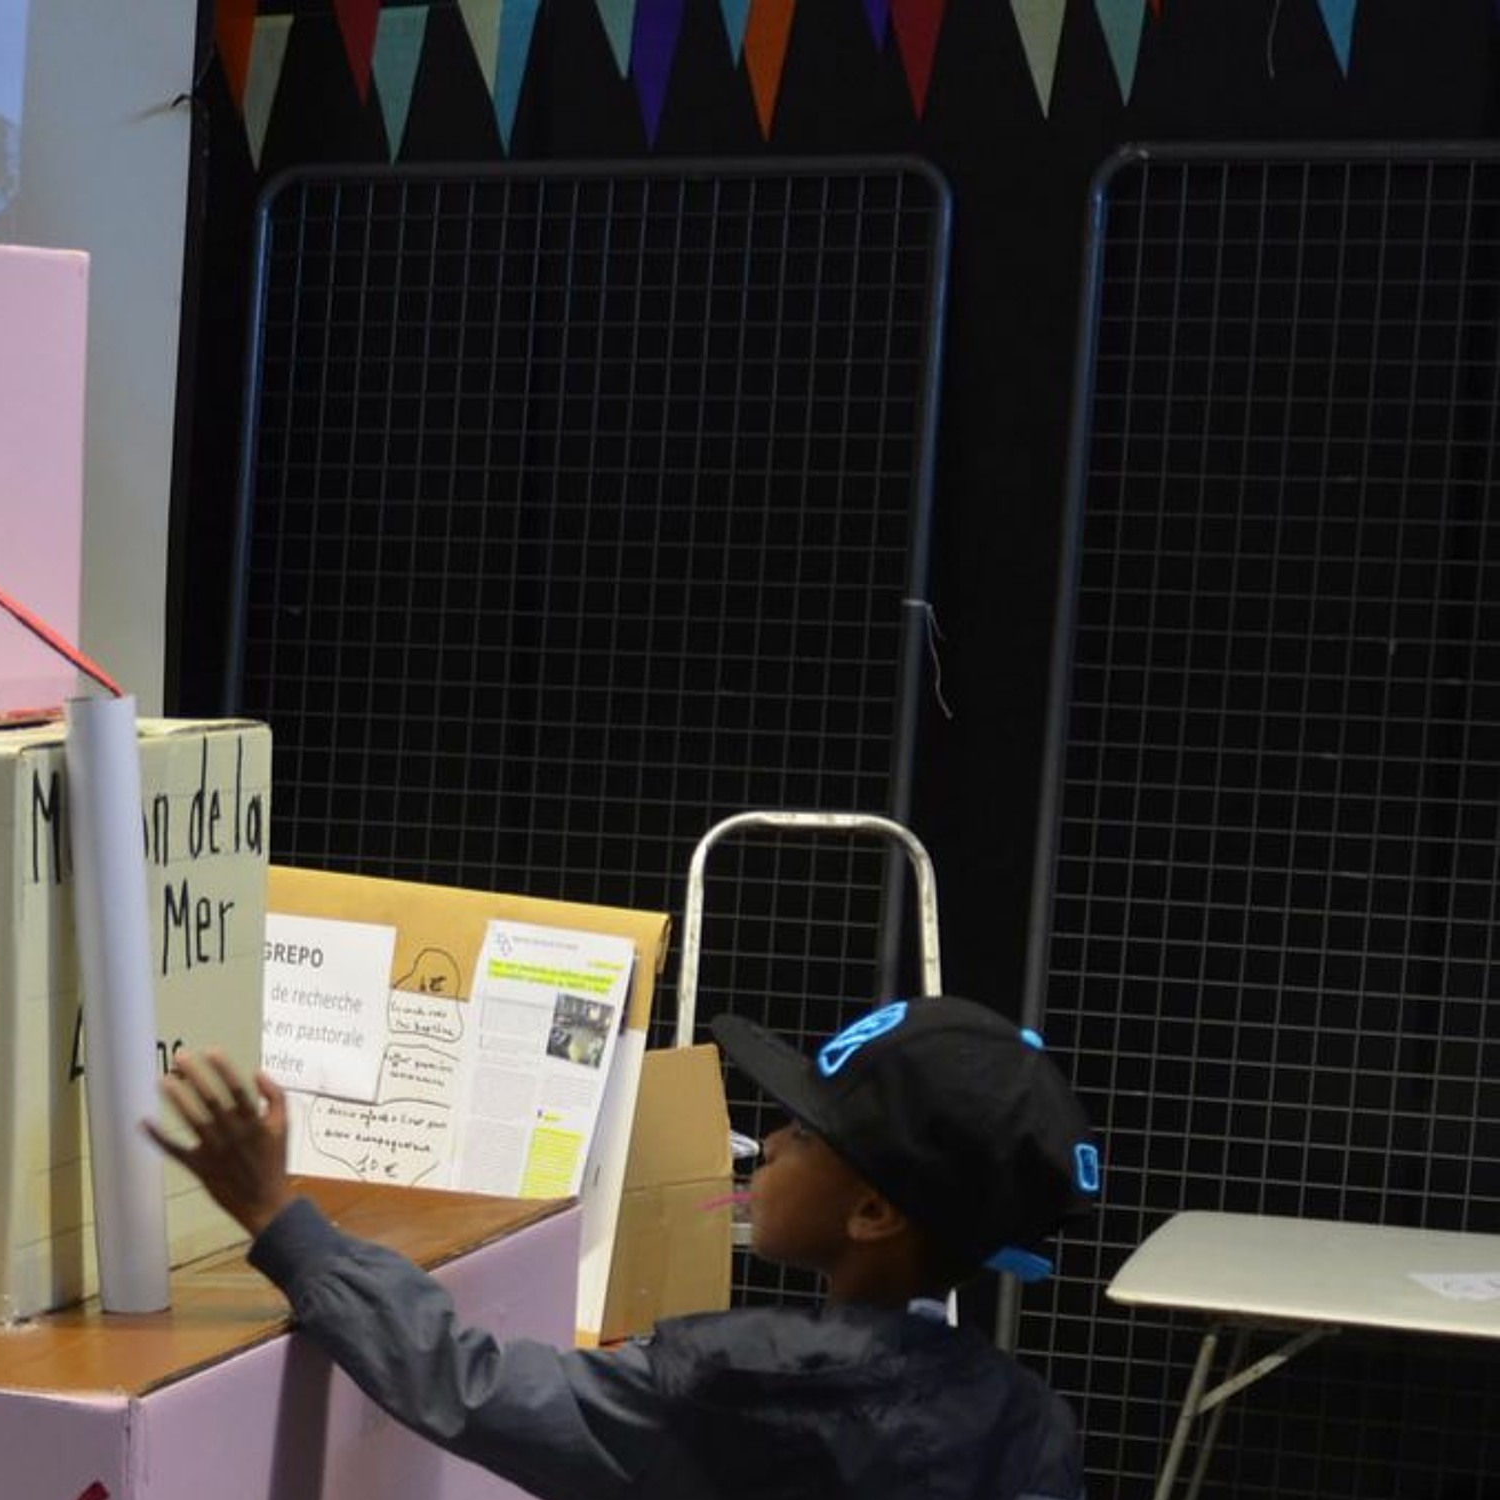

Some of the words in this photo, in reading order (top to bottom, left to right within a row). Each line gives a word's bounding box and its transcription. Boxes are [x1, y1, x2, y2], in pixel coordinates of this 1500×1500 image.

[188, 736, 222, 858] de
[234, 734, 263, 856] la
[161, 878, 235, 978] Mer
[262, 941, 325, 969] GREPO
[271, 983, 289, 1005] de
[291, 988, 363, 1014] recherche
[275, 1021, 293, 1037] en
[296, 1024, 365, 1048] pastorale
[264, 1050, 305, 1073] vrière
